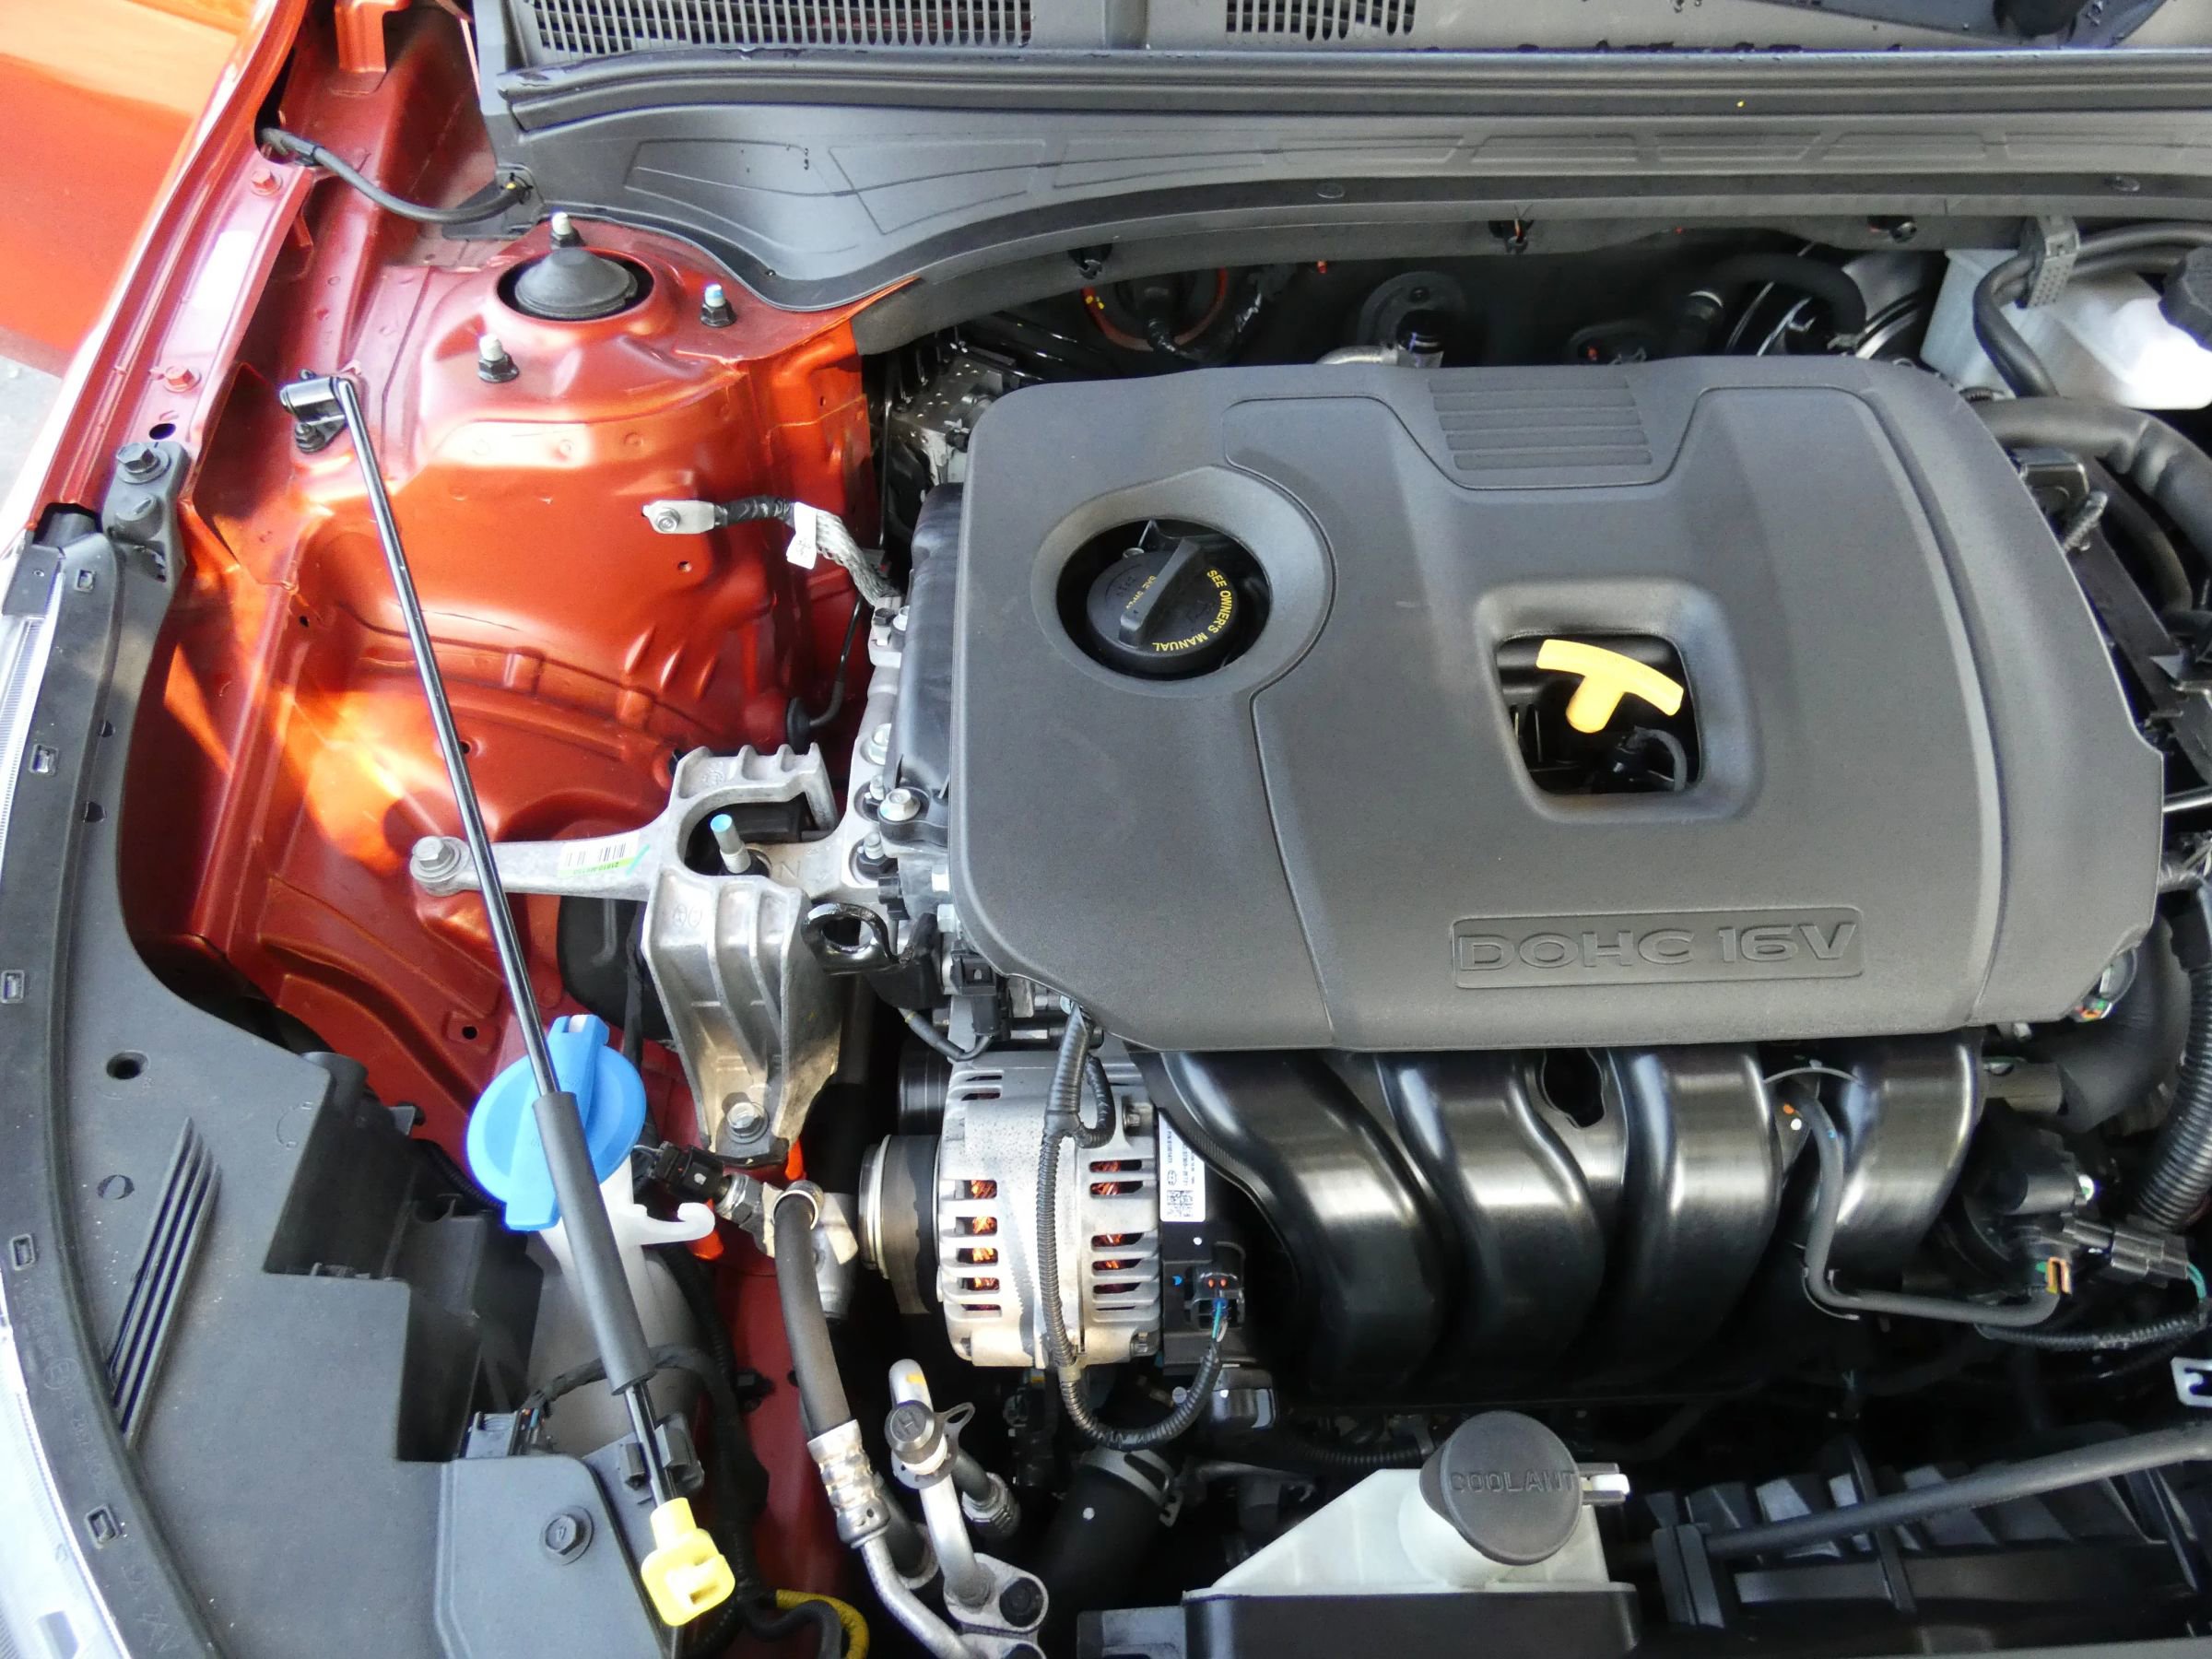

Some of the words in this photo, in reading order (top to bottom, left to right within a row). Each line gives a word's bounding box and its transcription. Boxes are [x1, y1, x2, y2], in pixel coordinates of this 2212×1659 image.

[1206, 570, 1228, 588] SEE
[1207, 590, 1232, 633] OWNER'S
[1152, 632, 1208, 652] MANUAL
[1458, 927, 1695, 971] DOHC
[1717, 922, 1855, 964] 16V
[1448, 1470, 1575, 1493] COOLANT
